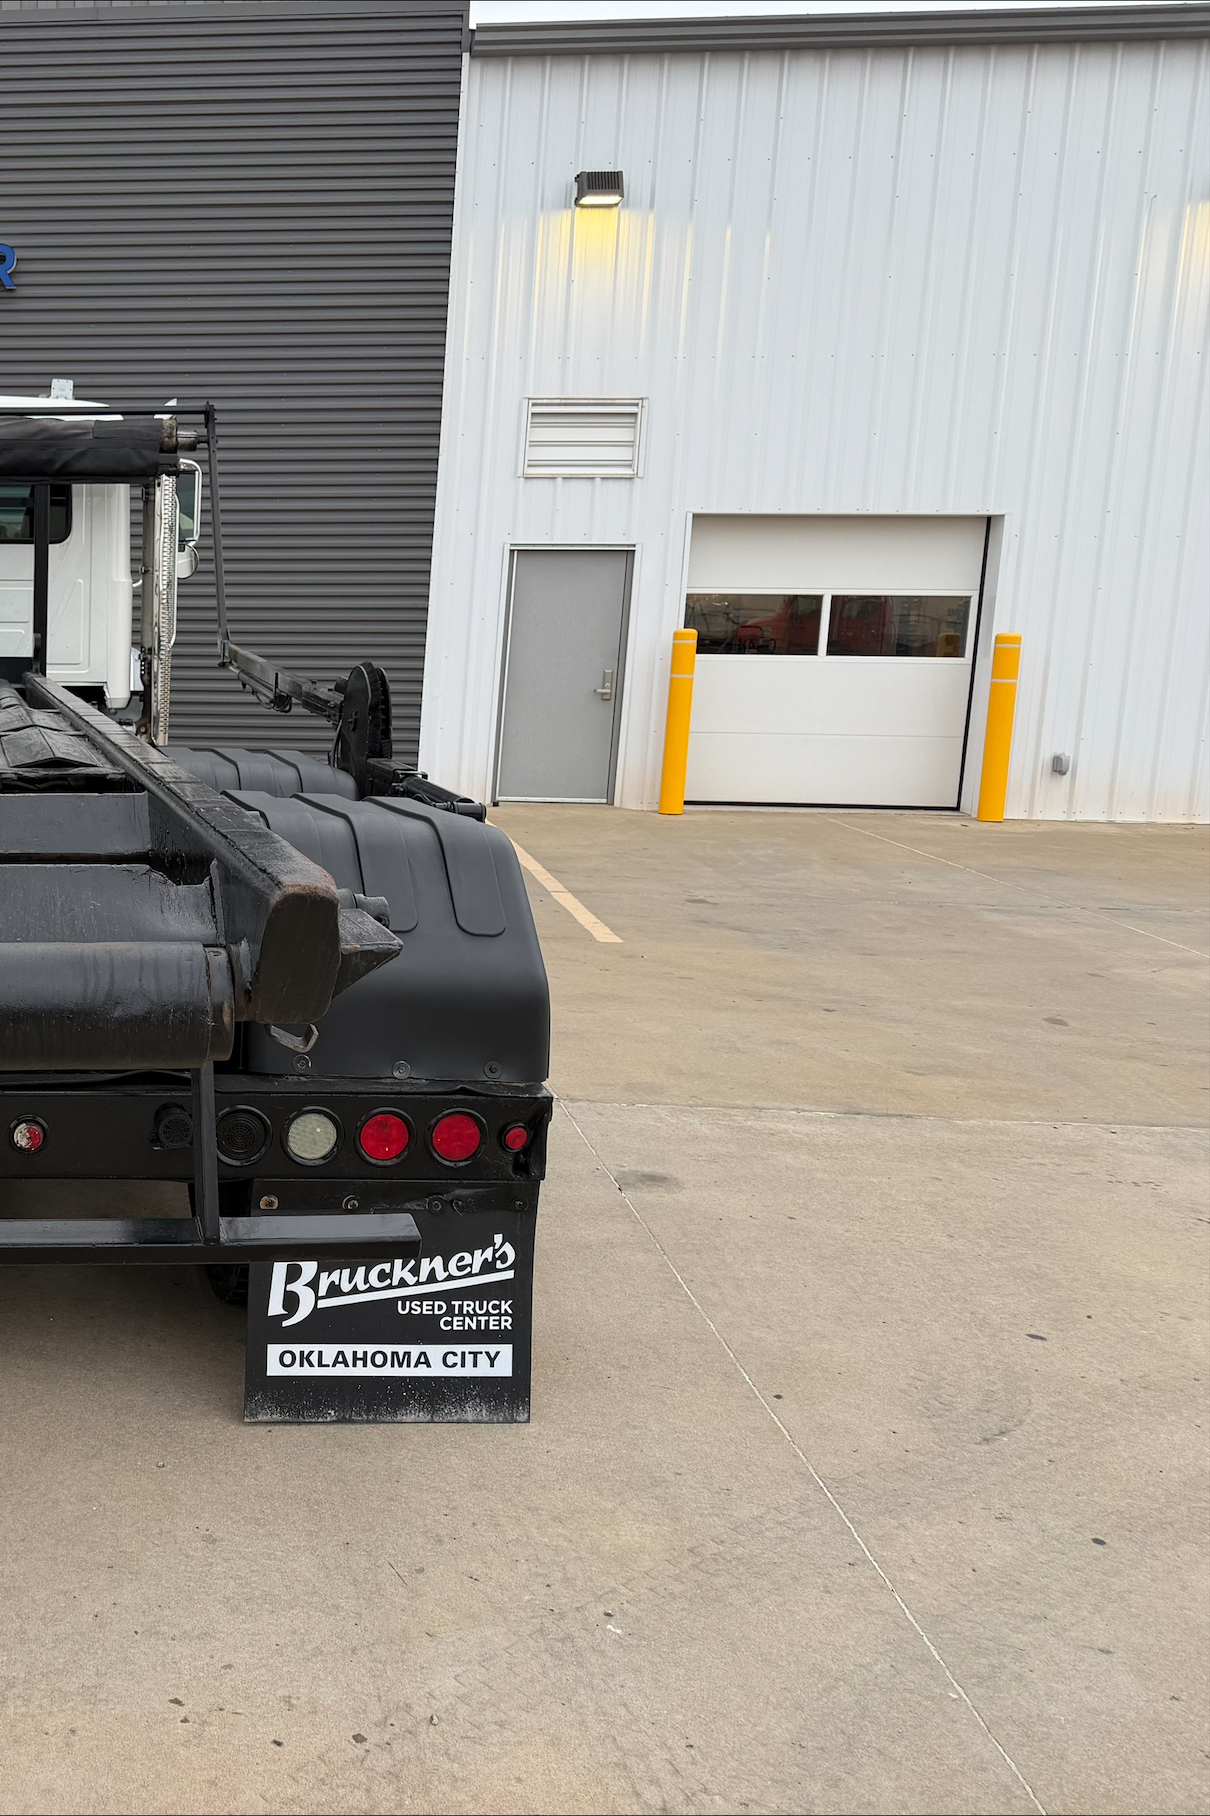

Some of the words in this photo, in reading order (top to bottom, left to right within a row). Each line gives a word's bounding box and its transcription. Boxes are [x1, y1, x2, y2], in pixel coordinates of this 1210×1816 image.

[267, 1233, 516, 1327] Bruckner's
[397, 1301, 446, 1315] USED
[451, 1300, 513, 1314] TRUCK
[440, 1316, 513, 1330] CENTER
[278, 1350, 431, 1369] OKLAHOMA
[442, 1350, 501, 1368] CITY
